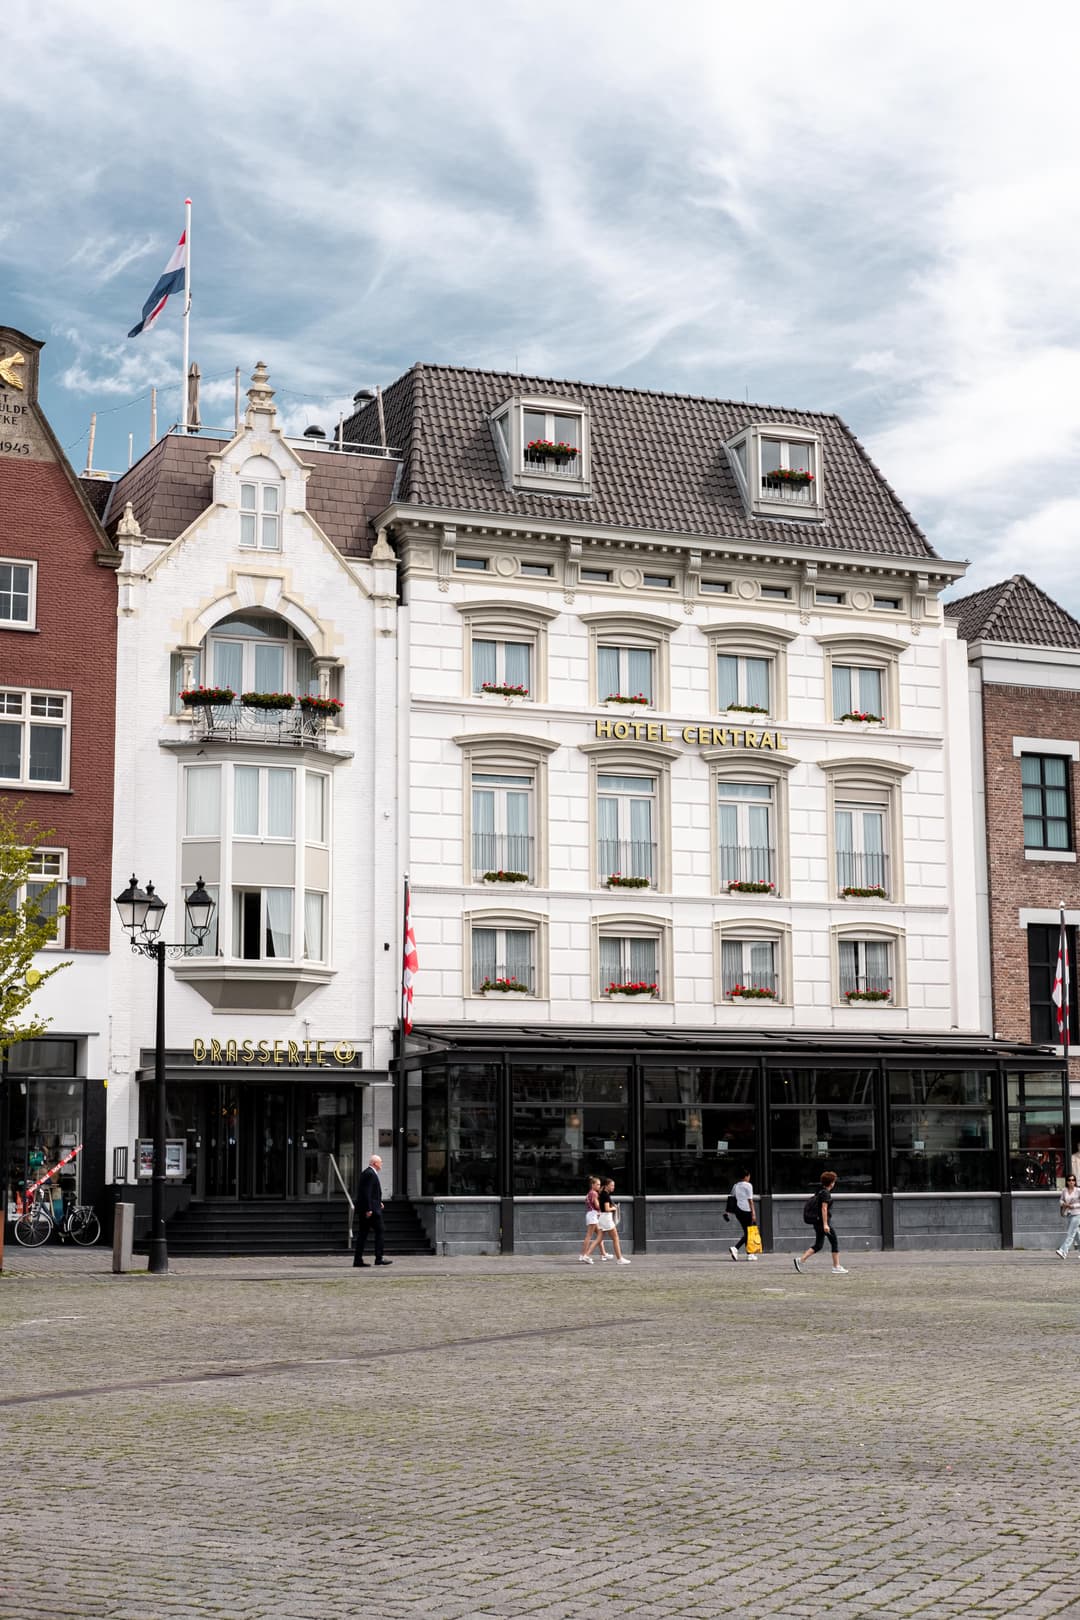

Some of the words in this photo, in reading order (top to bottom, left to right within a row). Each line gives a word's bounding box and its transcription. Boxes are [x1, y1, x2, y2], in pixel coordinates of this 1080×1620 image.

[0, 414, 18, 425] KE
[0, 440, 29, 454] 1945
[595, 719, 673, 742] HOTEL
[682, 726, 789, 750] CENTRAL
[193, 1038, 327, 1063] BRASSERIE
